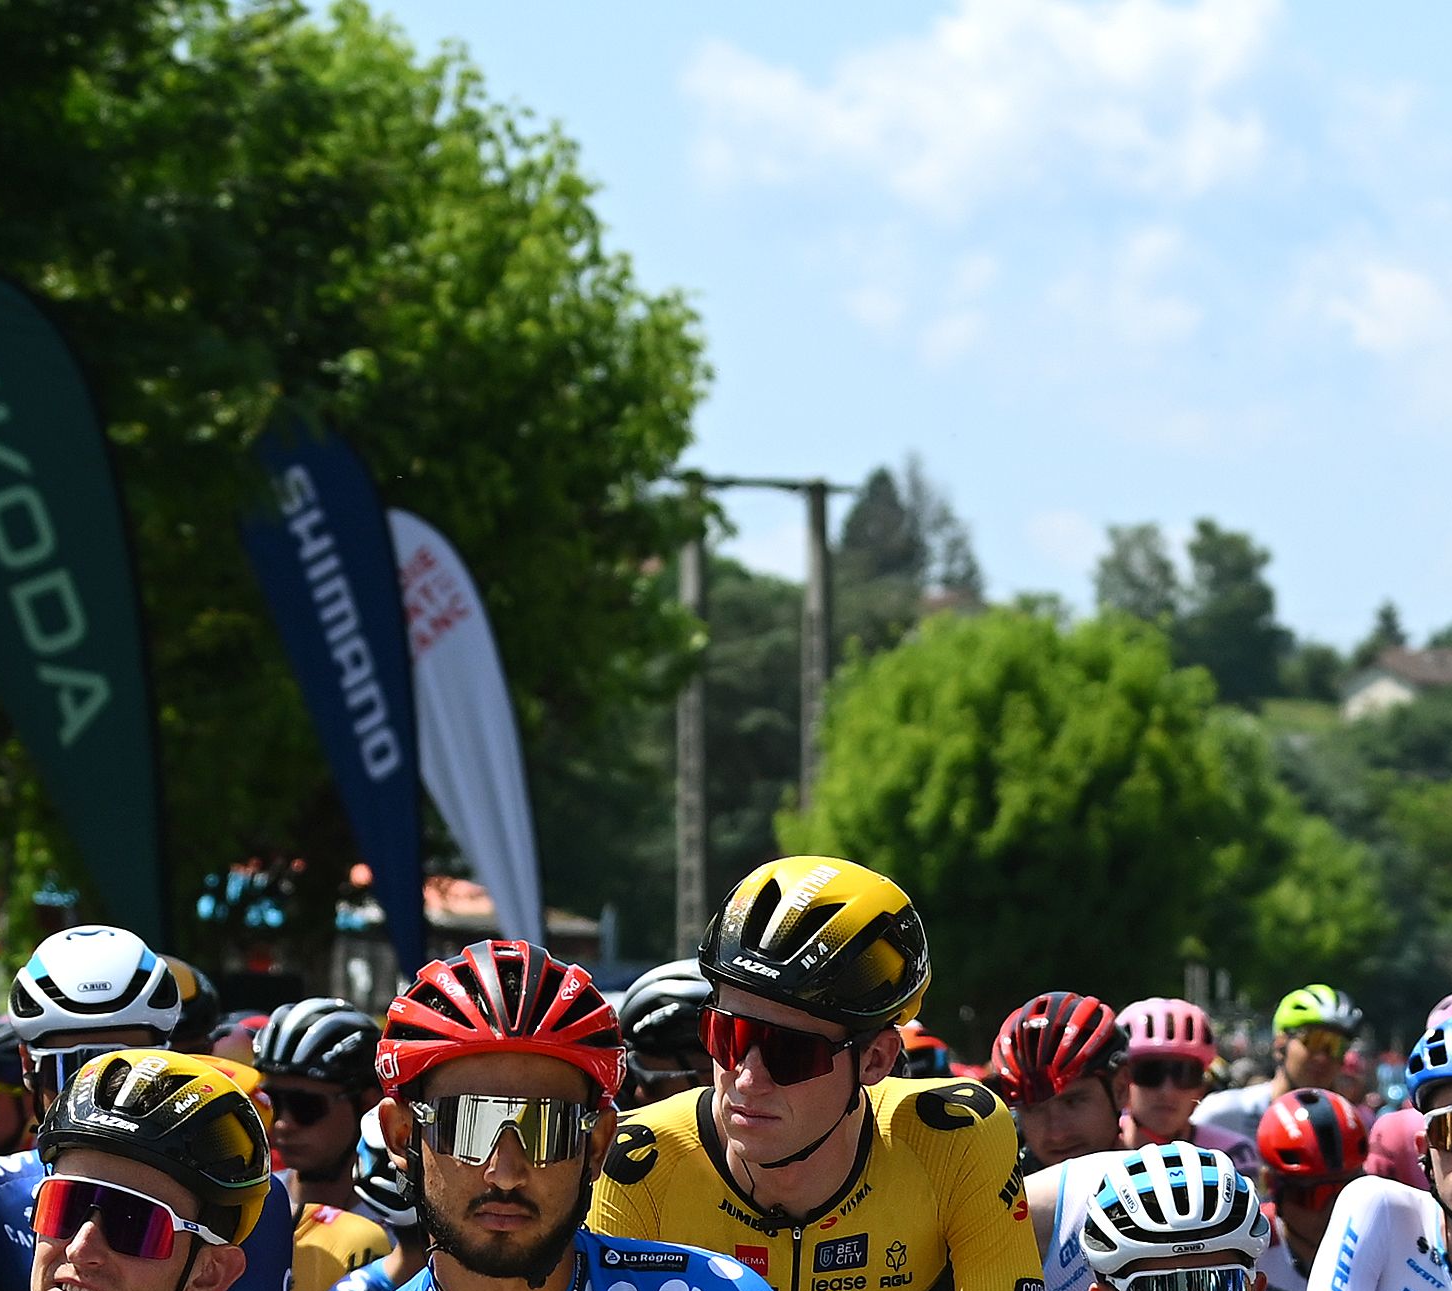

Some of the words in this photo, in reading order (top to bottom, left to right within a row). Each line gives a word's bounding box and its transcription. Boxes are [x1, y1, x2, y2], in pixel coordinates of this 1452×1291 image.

[280, 464, 402, 782] SHIMANO
[731, 956, 781, 980] LAZER
[86, 1111, 140, 1133] LAZER
[839, 1183, 873, 1217] VISMA
[623, 1252, 635, 1262] La
[637, 1252, 684, 1264] Région
[835, 1250, 863, 1266] CITY
[836, 1242, 859, 1255] BET
[879, 1271, 913, 1288] AGU
[1406, 1258, 1446, 1288] GIANT
[811, 1275, 867, 1291] lease
